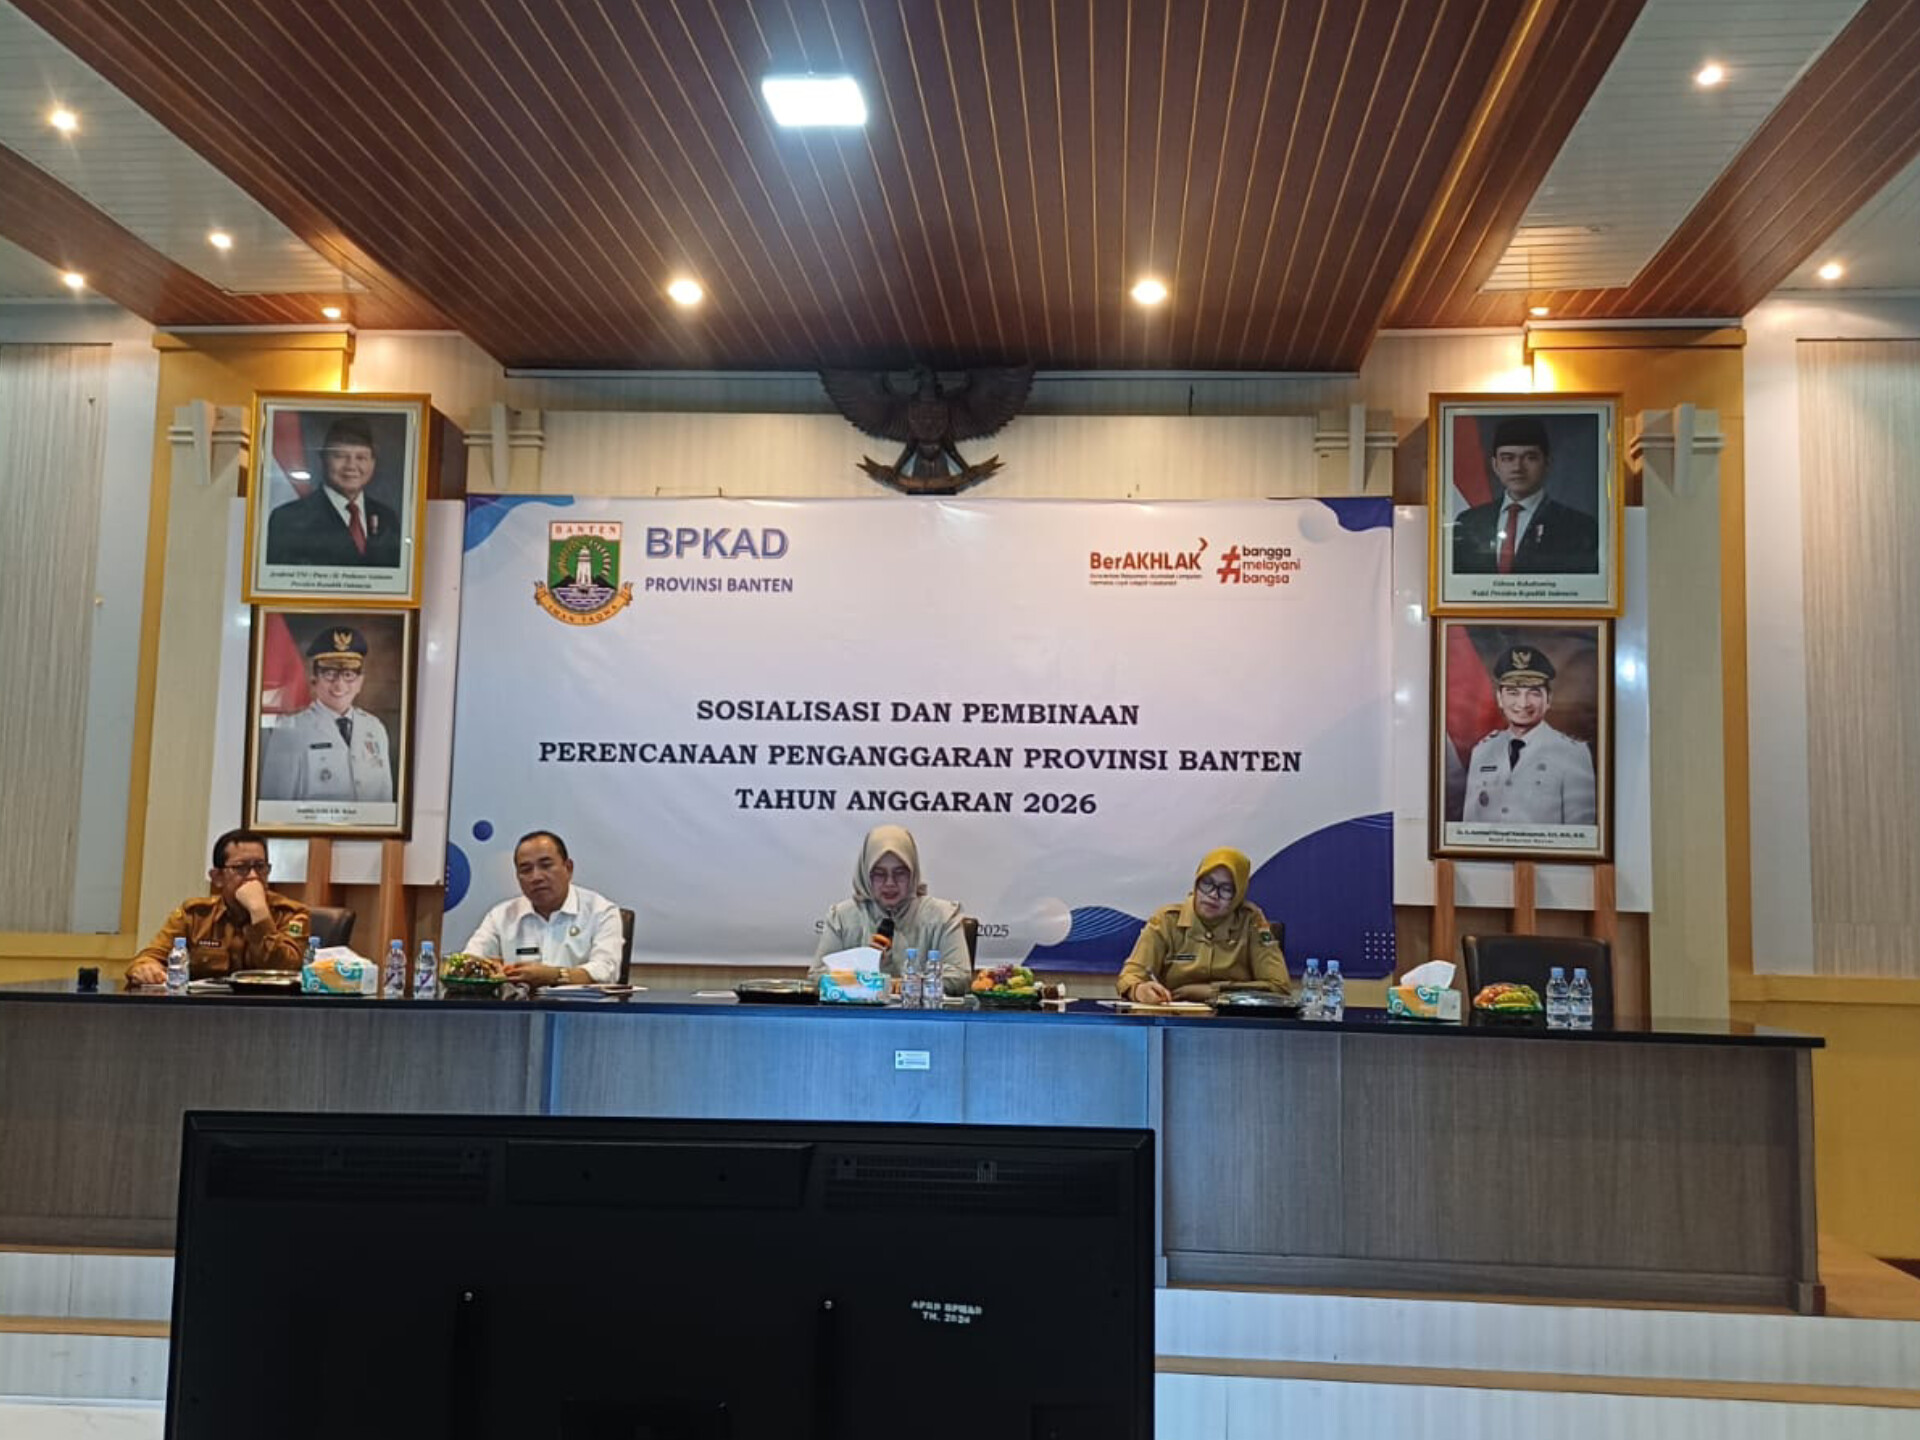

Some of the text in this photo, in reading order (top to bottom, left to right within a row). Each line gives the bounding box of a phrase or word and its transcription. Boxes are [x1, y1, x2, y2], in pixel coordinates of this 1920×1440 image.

[646, 527, 788, 559] BPKAD
[1090, 551, 1202, 570] BerAKHLAK
[1243, 546, 1292, 561] bangga
[1243, 559, 1301, 575] melayani
[645, 577, 793, 593] PROVINSI BANTEN
[1243, 573, 1290, 587] bangsa
[697, 700, 1139, 725] SOSIALISASI DAN PEMBINAAN
[539, 742, 1302, 772] PERENCANAAN PENGANGGARAN PROVINSI BANTEN
[735, 789, 1097, 814] TAHUN ANGGARAN 2026
[976, 924, 1009, 937] 2025
